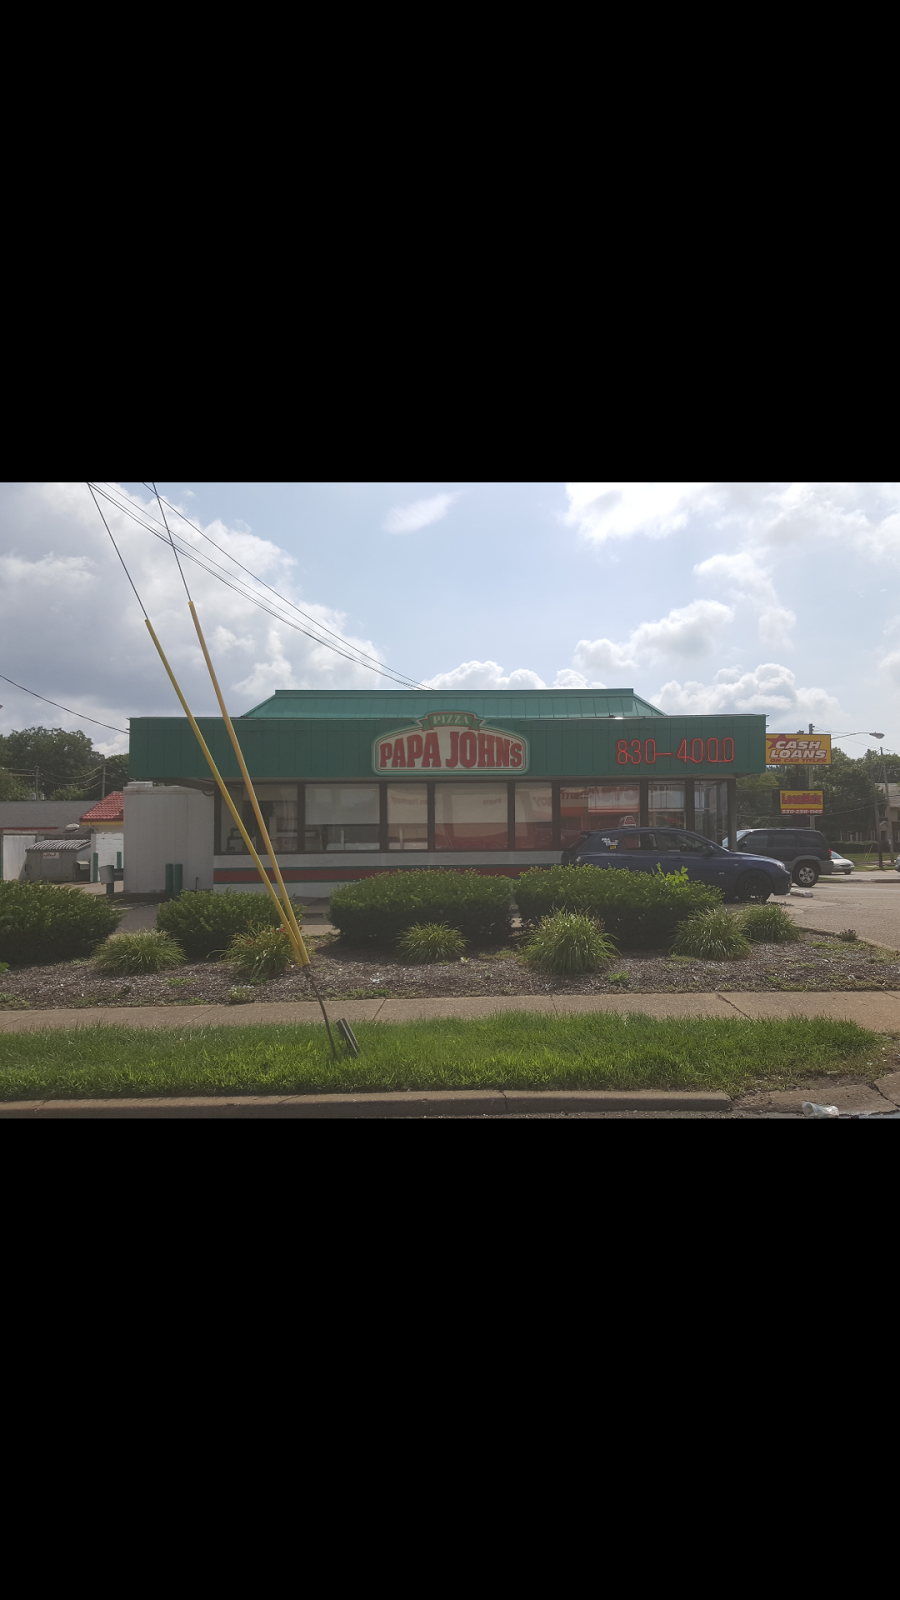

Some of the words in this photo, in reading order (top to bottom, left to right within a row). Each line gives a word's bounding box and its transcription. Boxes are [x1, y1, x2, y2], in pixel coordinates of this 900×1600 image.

[432, 714, 470, 725] PIZZA
[380, 732, 442, 768] PAPA
[445, 731, 523, 768] JOHN'S
[775, 741, 821, 750] CASH
[617, 738, 735, 765] 830-4000
[769, 750, 827, 759] LOANS
[782, 793, 822, 805] LoanMax
